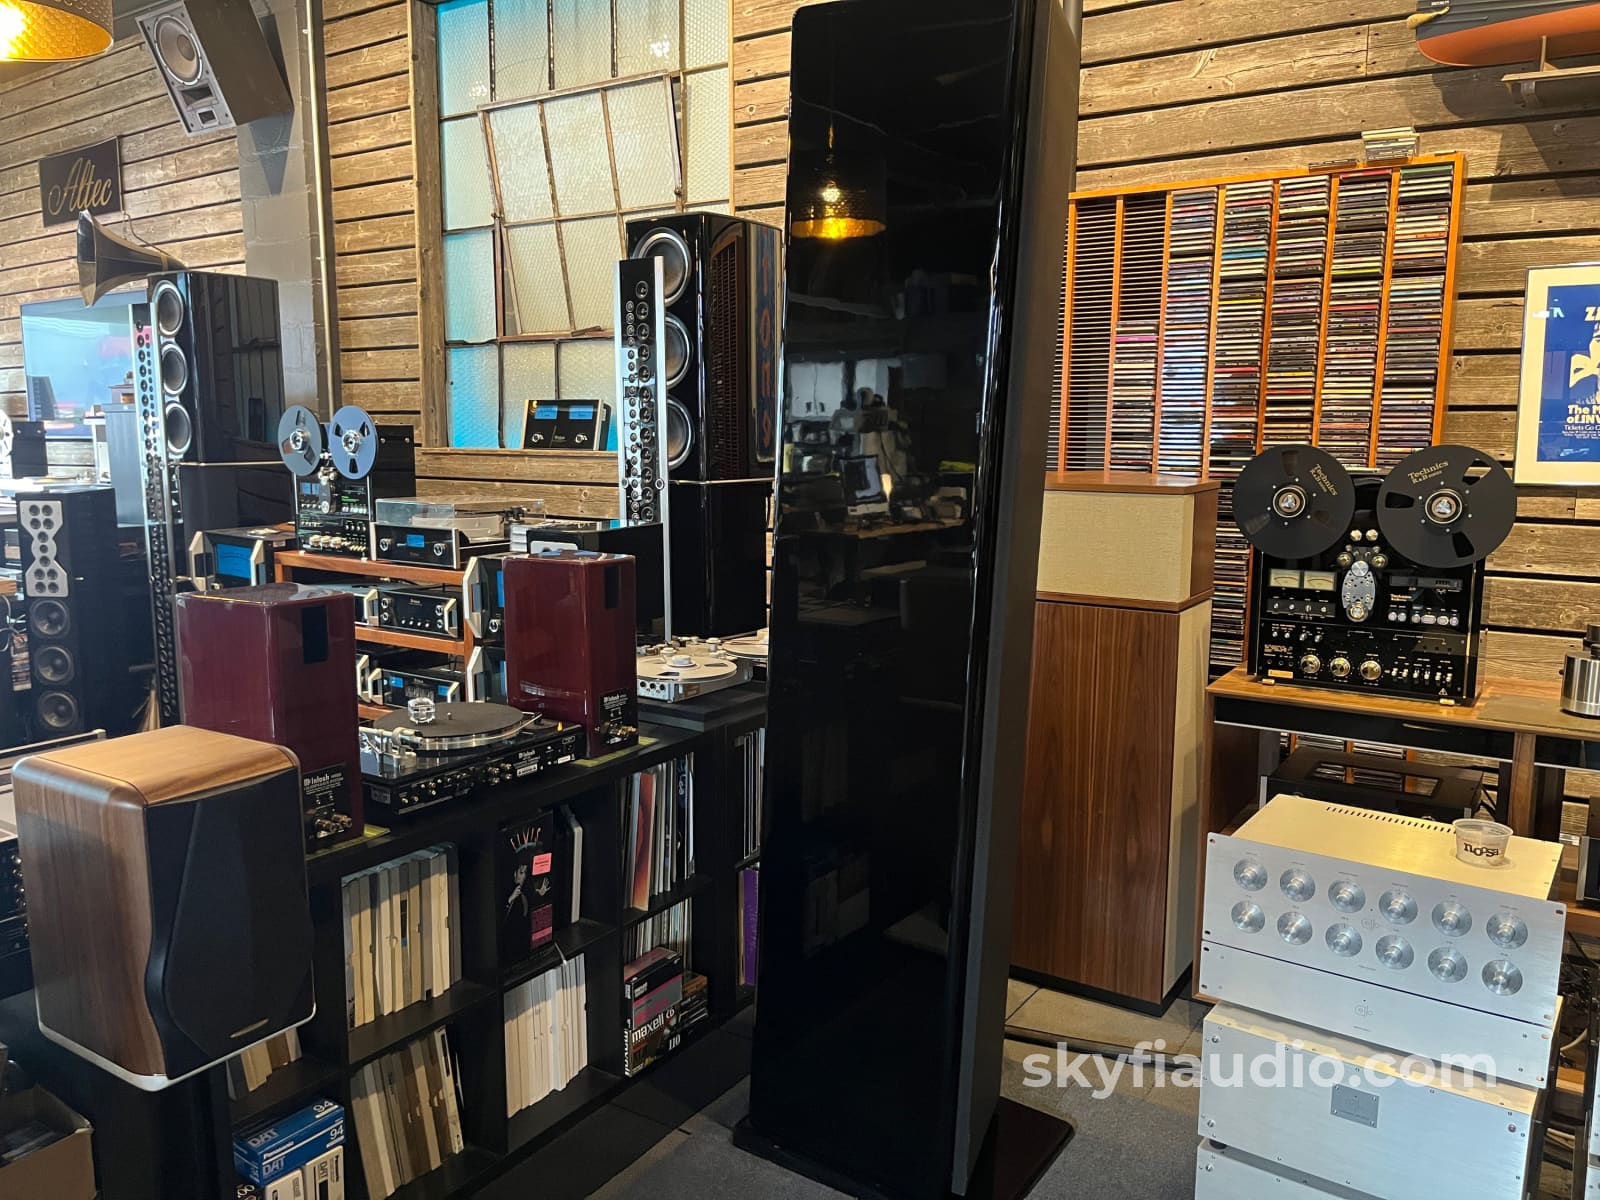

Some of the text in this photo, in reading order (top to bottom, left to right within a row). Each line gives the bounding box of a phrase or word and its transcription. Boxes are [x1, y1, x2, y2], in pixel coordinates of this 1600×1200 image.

[48, 157, 113, 215] Altec
[1567, 404, 1590, 415] The
[1407, 460, 1449, 479] Technics
[1313, 463, 1338, 496] Technics
[631, 1011, 665, 1044] maxell
[312, 1100, 334, 1113] 94
[248, 1128, 279, 1147] DAT
[330, 1125, 344, 1139] 94
[263, 1157, 286, 1177] DAT
